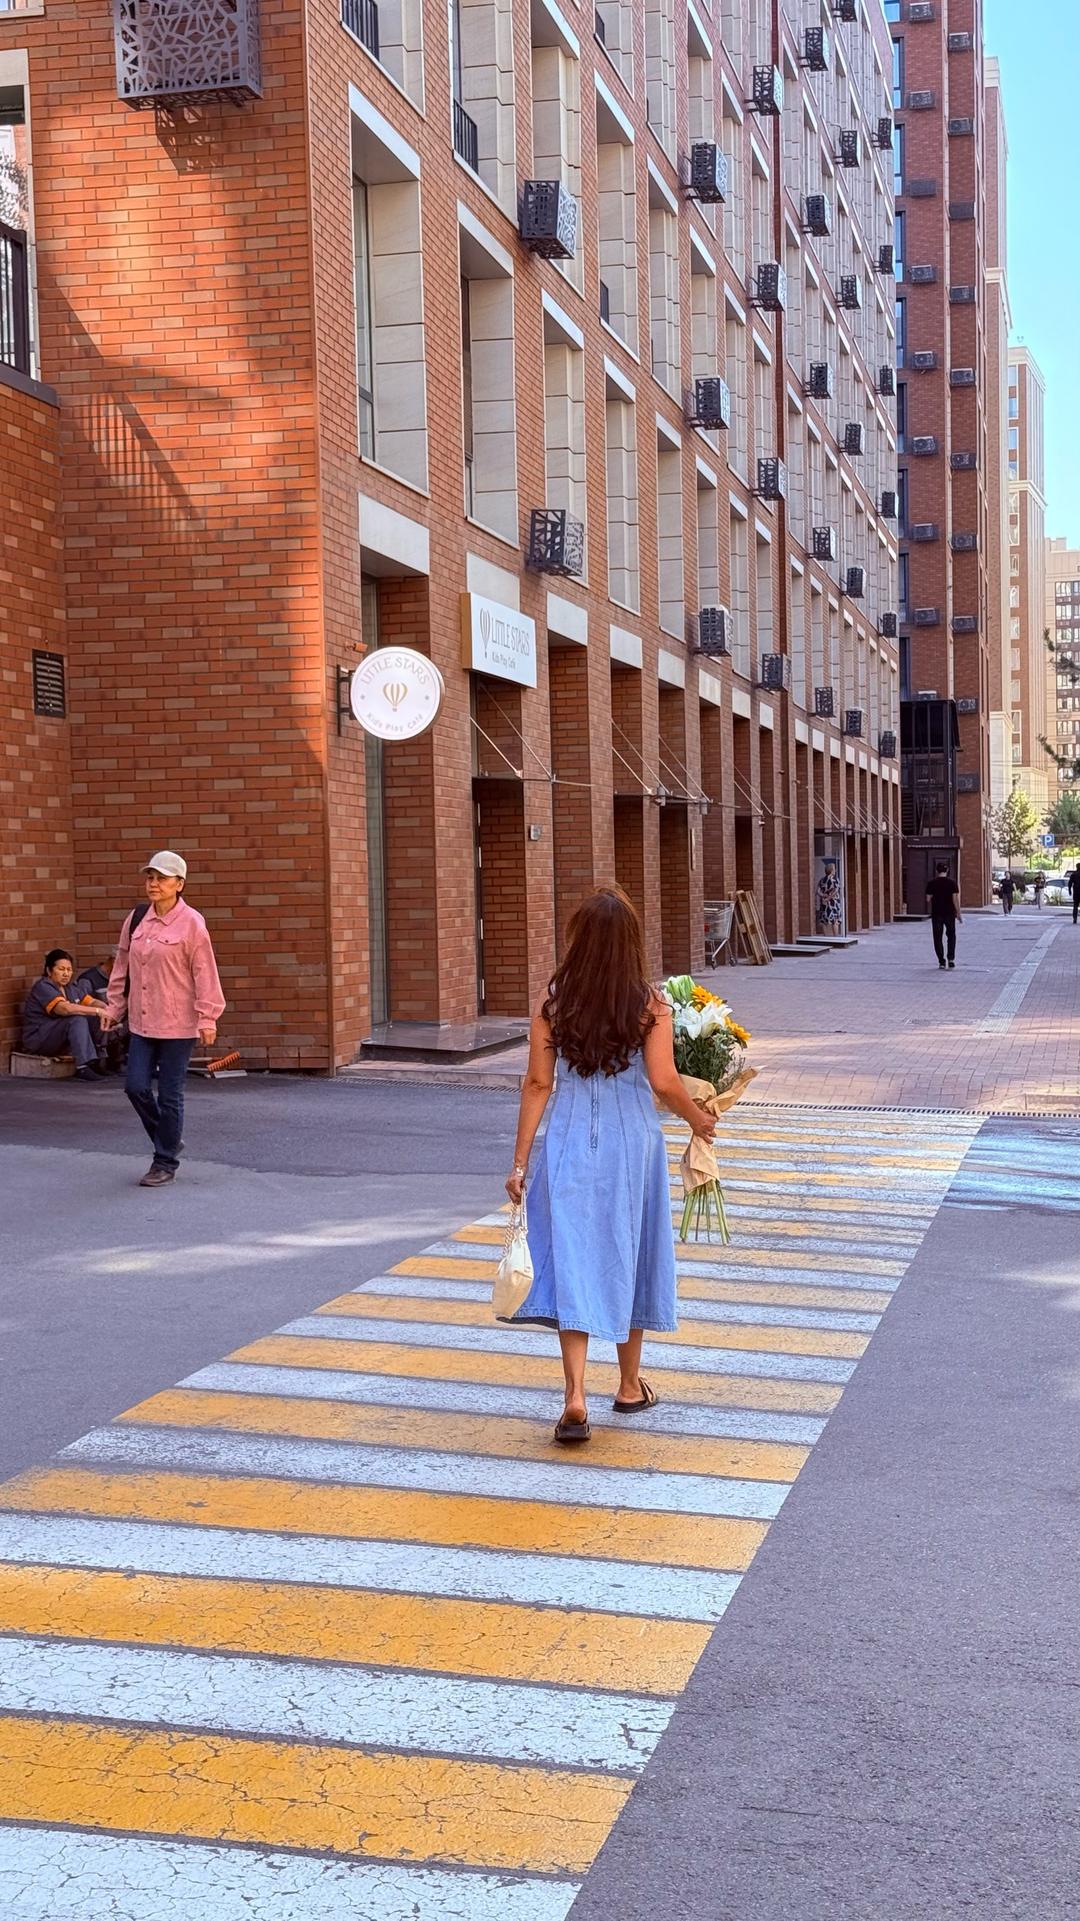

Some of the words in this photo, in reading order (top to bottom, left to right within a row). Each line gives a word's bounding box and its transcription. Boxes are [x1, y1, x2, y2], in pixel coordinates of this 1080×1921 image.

[491, 617, 510, 649] LITTLE
[511, 626, 530, 656] STARS
[360, 656, 393, 686] LITTLE
[394, 656, 430, 685] STARS
[1044, 836, 1052, 846] P
